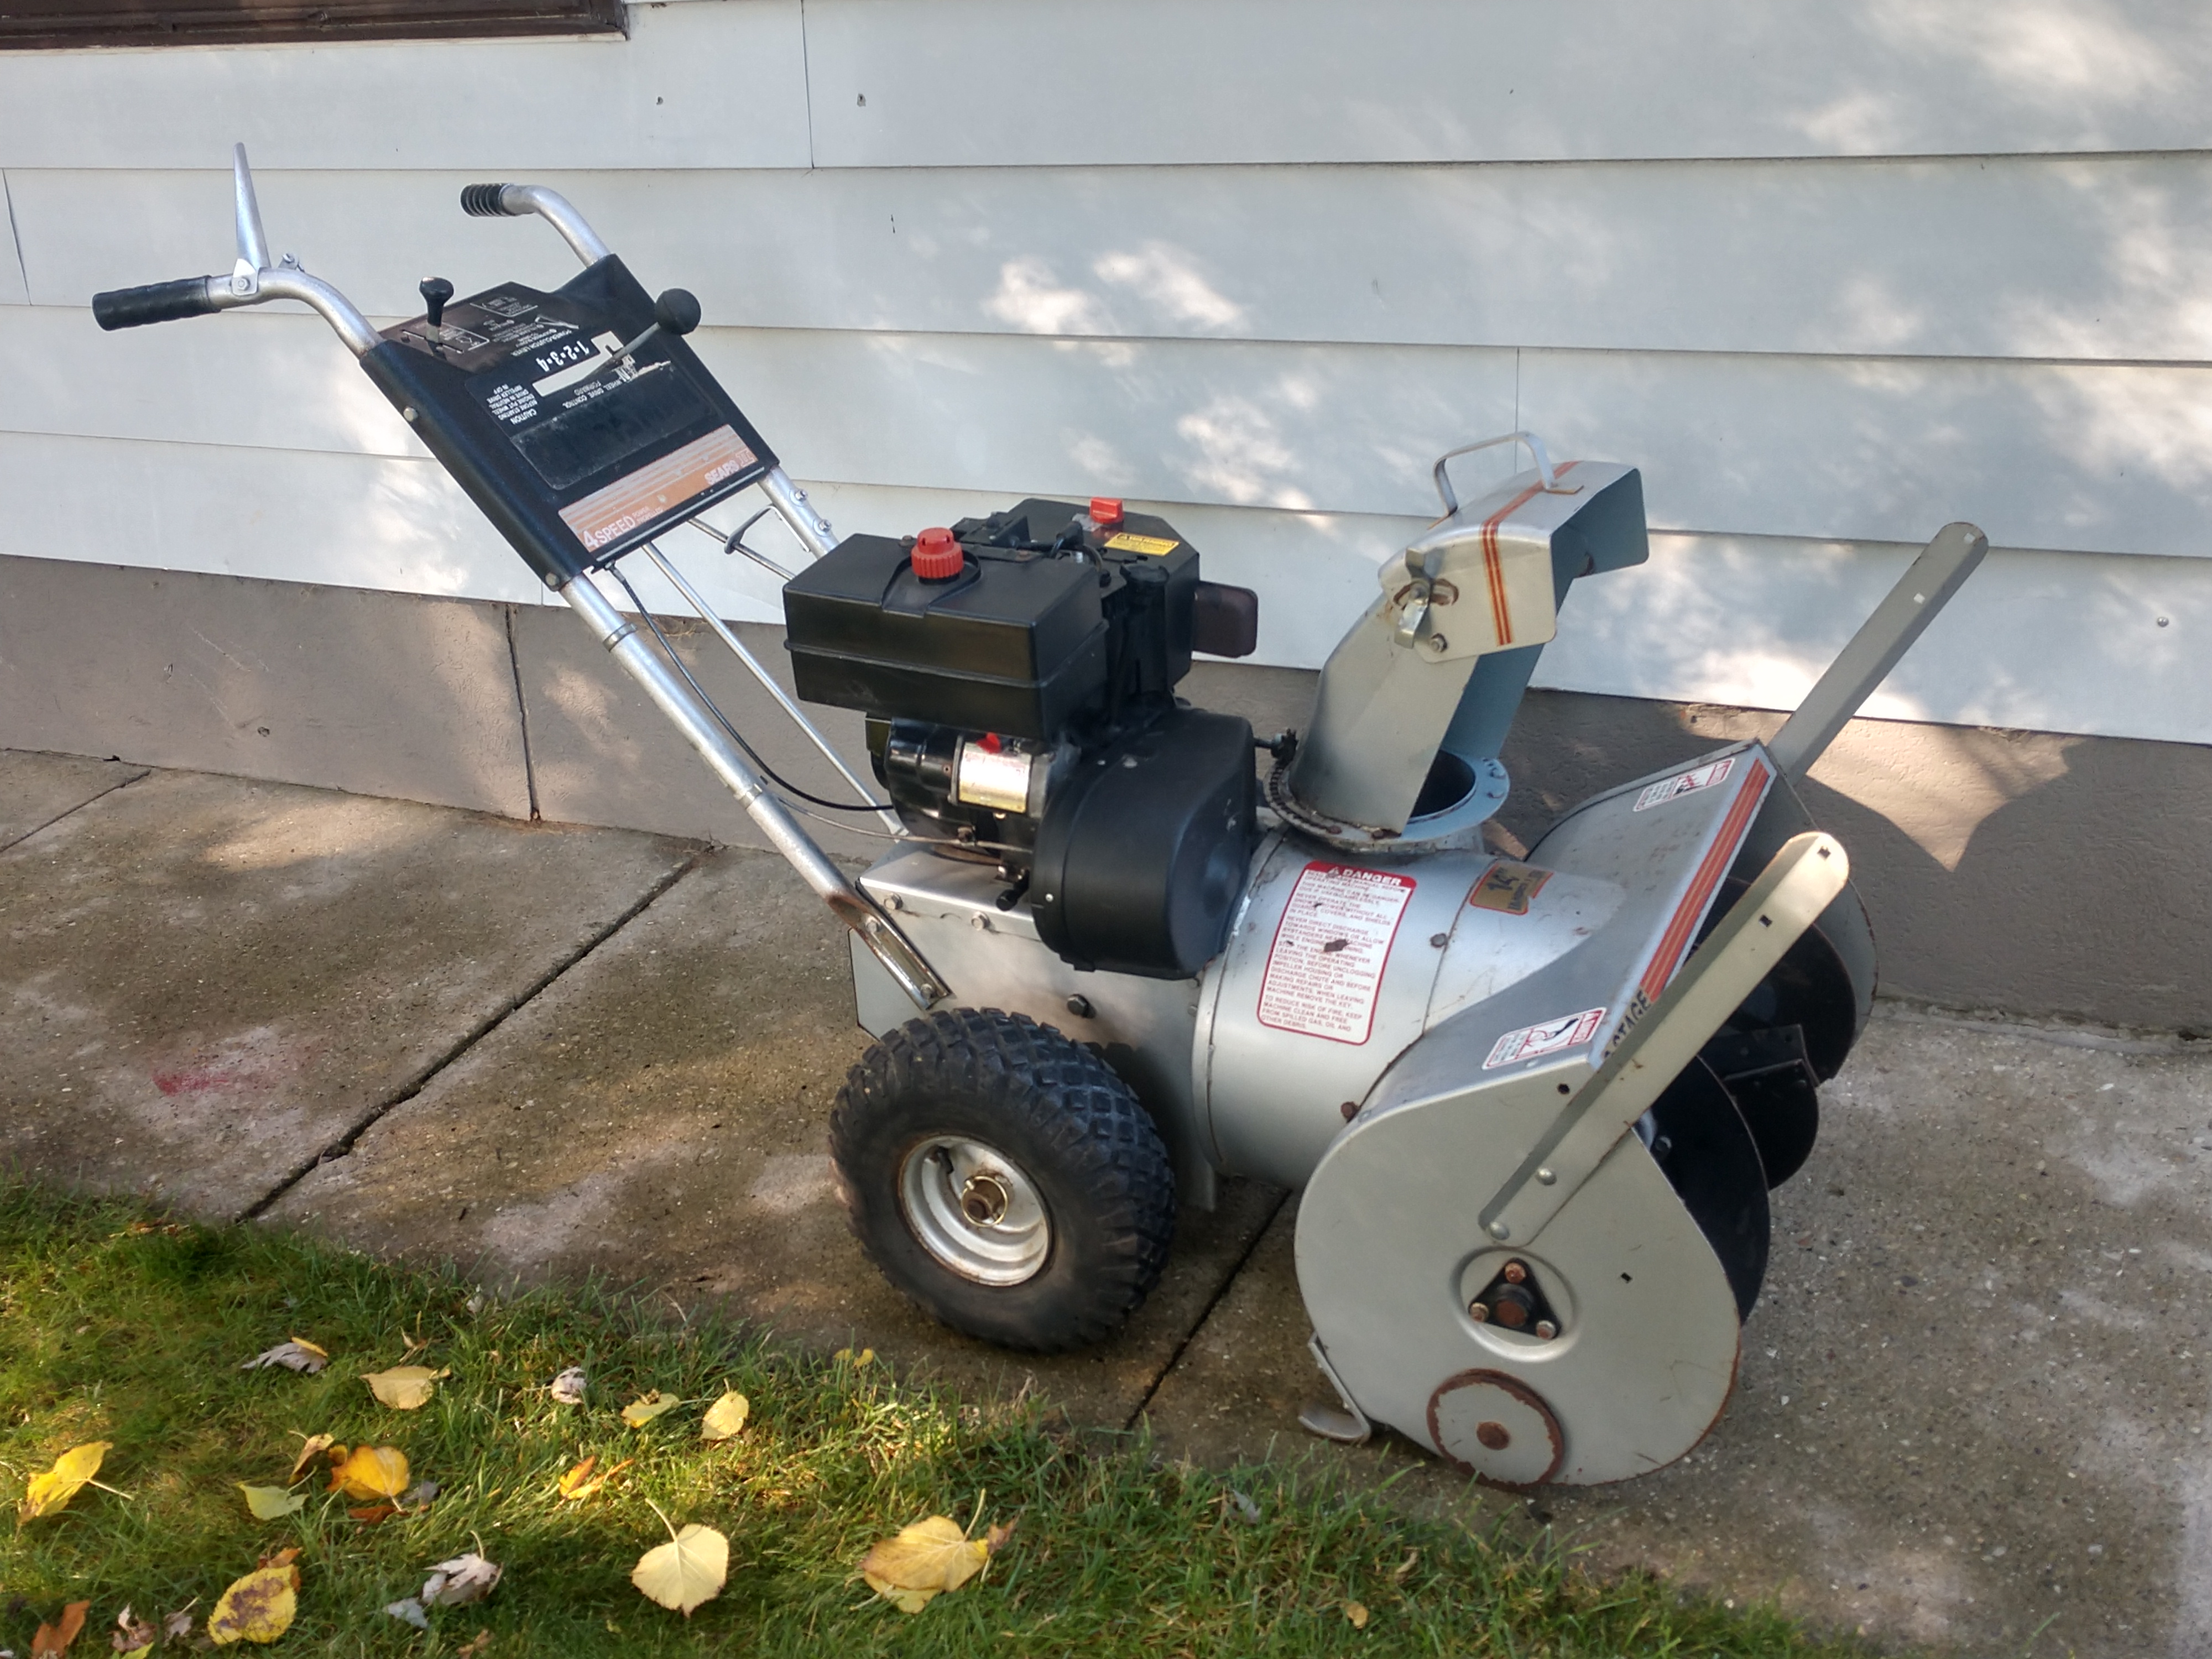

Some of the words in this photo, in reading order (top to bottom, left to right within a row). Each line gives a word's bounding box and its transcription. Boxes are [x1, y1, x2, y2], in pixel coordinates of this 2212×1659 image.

[574, 381, 601, 395] FORWARD
[603, 378, 622, 390] WHEEL
[501, 385, 522, 398] IMPELLER
[515, 389, 529, 398] DRIVE
[588, 388, 604, 398] DRIVE
[487, 394, 501, 403] DRIVE
[489, 398, 510, 409] NEUTRAL
[517, 394, 534, 404] ENGINE
[563, 395, 587, 408] CONTROL
[492, 406, 509, 414] WHEEL
[519, 399, 537, 410] BEFORE
[498, 408, 520, 420] STARTING
[510, 409, 536, 424] CAUTION
[705, 460, 739, 486] SEARS
[582, 530, 599, 548] 4
[594, 516, 637, 544] SPEED
[1342, 869, 1401, 884] DANGER
[1318, 896, 1346, 905] OPERATE
[1345, 907, 1374, 916] WITHOUT
[1365, 917, 1390, 925] SHIELDS
[1283, 927, 1322, 938] BYSTANDERS
[1285, 921, 1315, 930] TOWARDS
[1317, 927, 1348, 937] WINDOWS
[1332, 924, 1368, 935] DISCHARGE
[1276, 947, 1303, 956] LEAVING
[1318, 956, 1354, 966] OPERATING
[1335, 952, 1370, 963] WHENEVER
[1272, 961, 1302, 970] IMPELLER
[1304, 967, 1332, 975] HOUSING
[1307, 960, 1331, 969] BEFORE
[1333, 966, 1375, 978] UNCLOGGING
[1270, 973, 1294, 982] MAKING
[1295, 978, 1322, 987] REPAIRS
[1271, 967, 1306, 977] DISCHARGE
[1346, 982, 1370, 990] BEFORE
[1266, 987, 1294, 995] MACHINE
[1296, 993, 1322, 1001] REMOVE
[1337, 994, 1364, 1003] LEAVING
[1263, 1001, 1291, 1011] MACHINE
[1275, 997, 1299, 1005] REDUCE
[1261, 1015, 1282, 1023] OTHER
[1281, 1013, 1307, 1022] SPILLED
